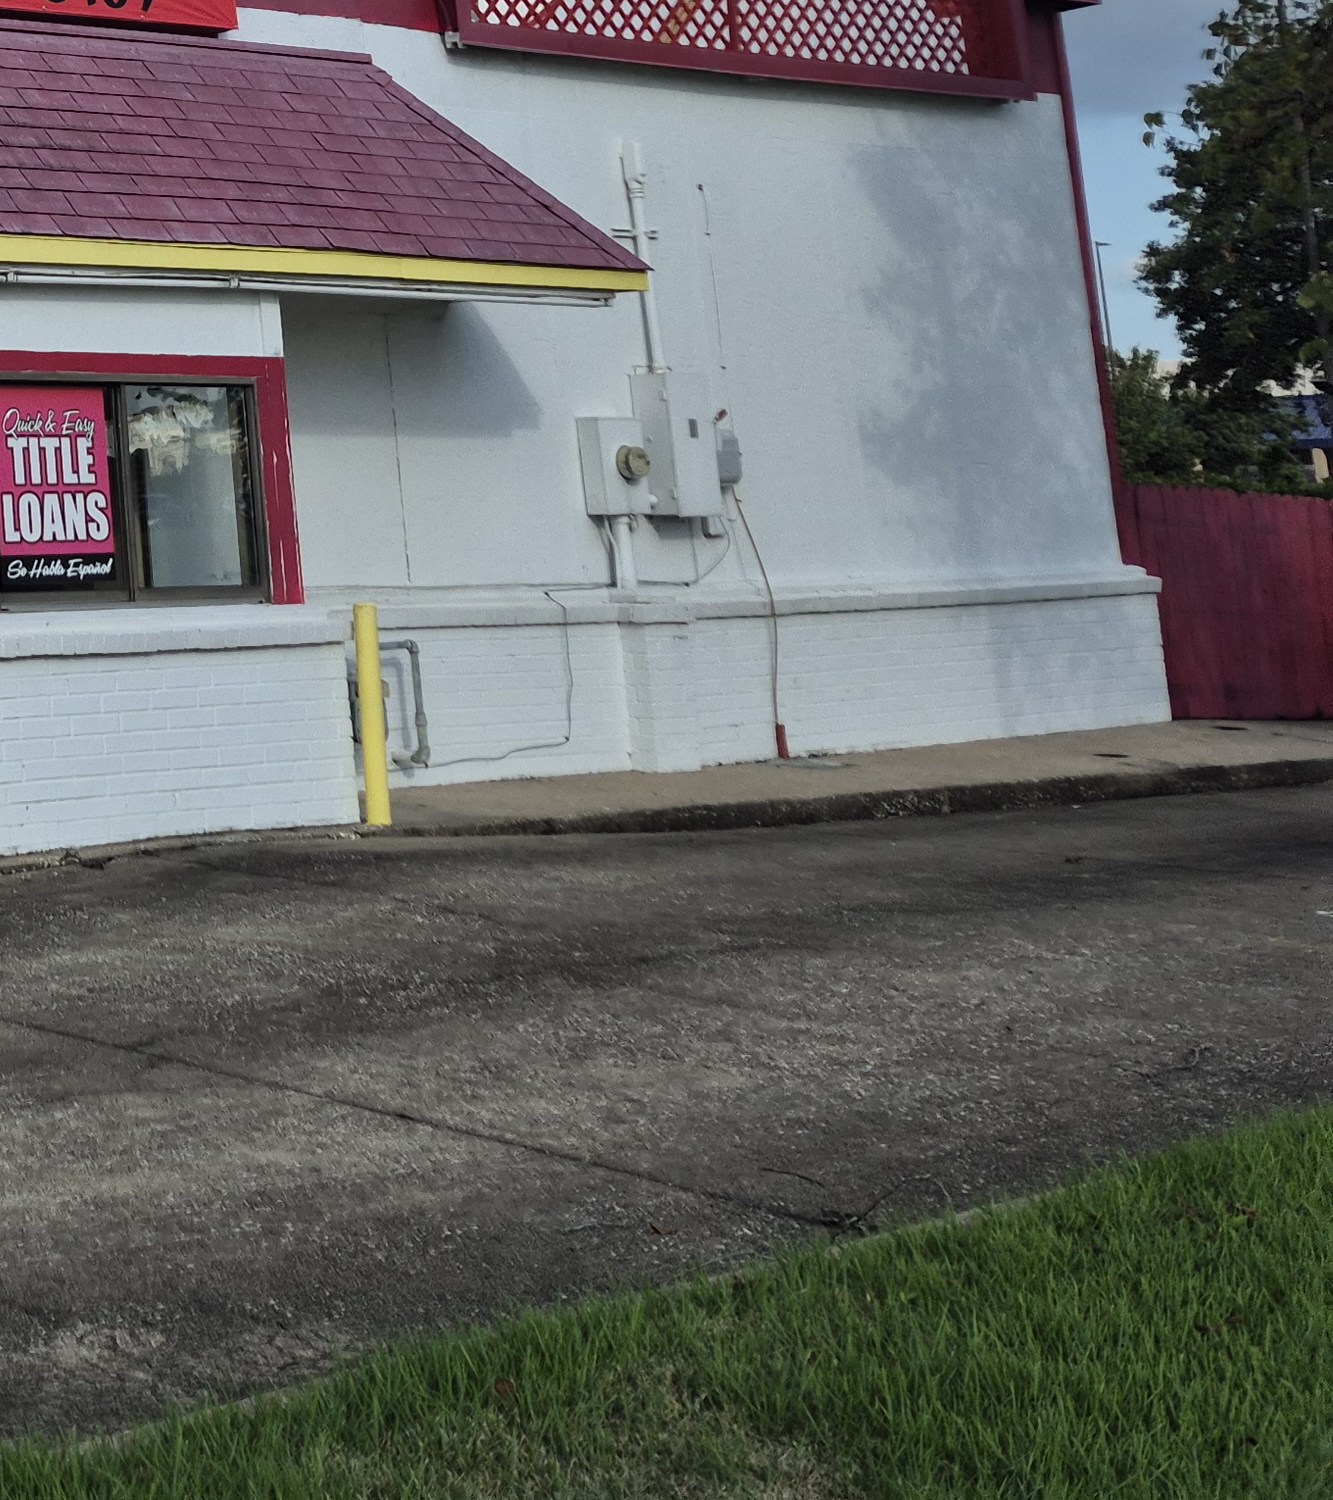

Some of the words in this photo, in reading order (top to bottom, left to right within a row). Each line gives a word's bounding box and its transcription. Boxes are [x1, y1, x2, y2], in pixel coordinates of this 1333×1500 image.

[2, 408, 44, 440] Quick
[44, 409, 56, 434] &
[61, 410, 96, 444] Easy
[6, 435, 97, 486] TITLE
[1, 491, 111, 543] LOANS
[28, 556, 65, 579] Habla
[66, 557, 113, 581] Español
